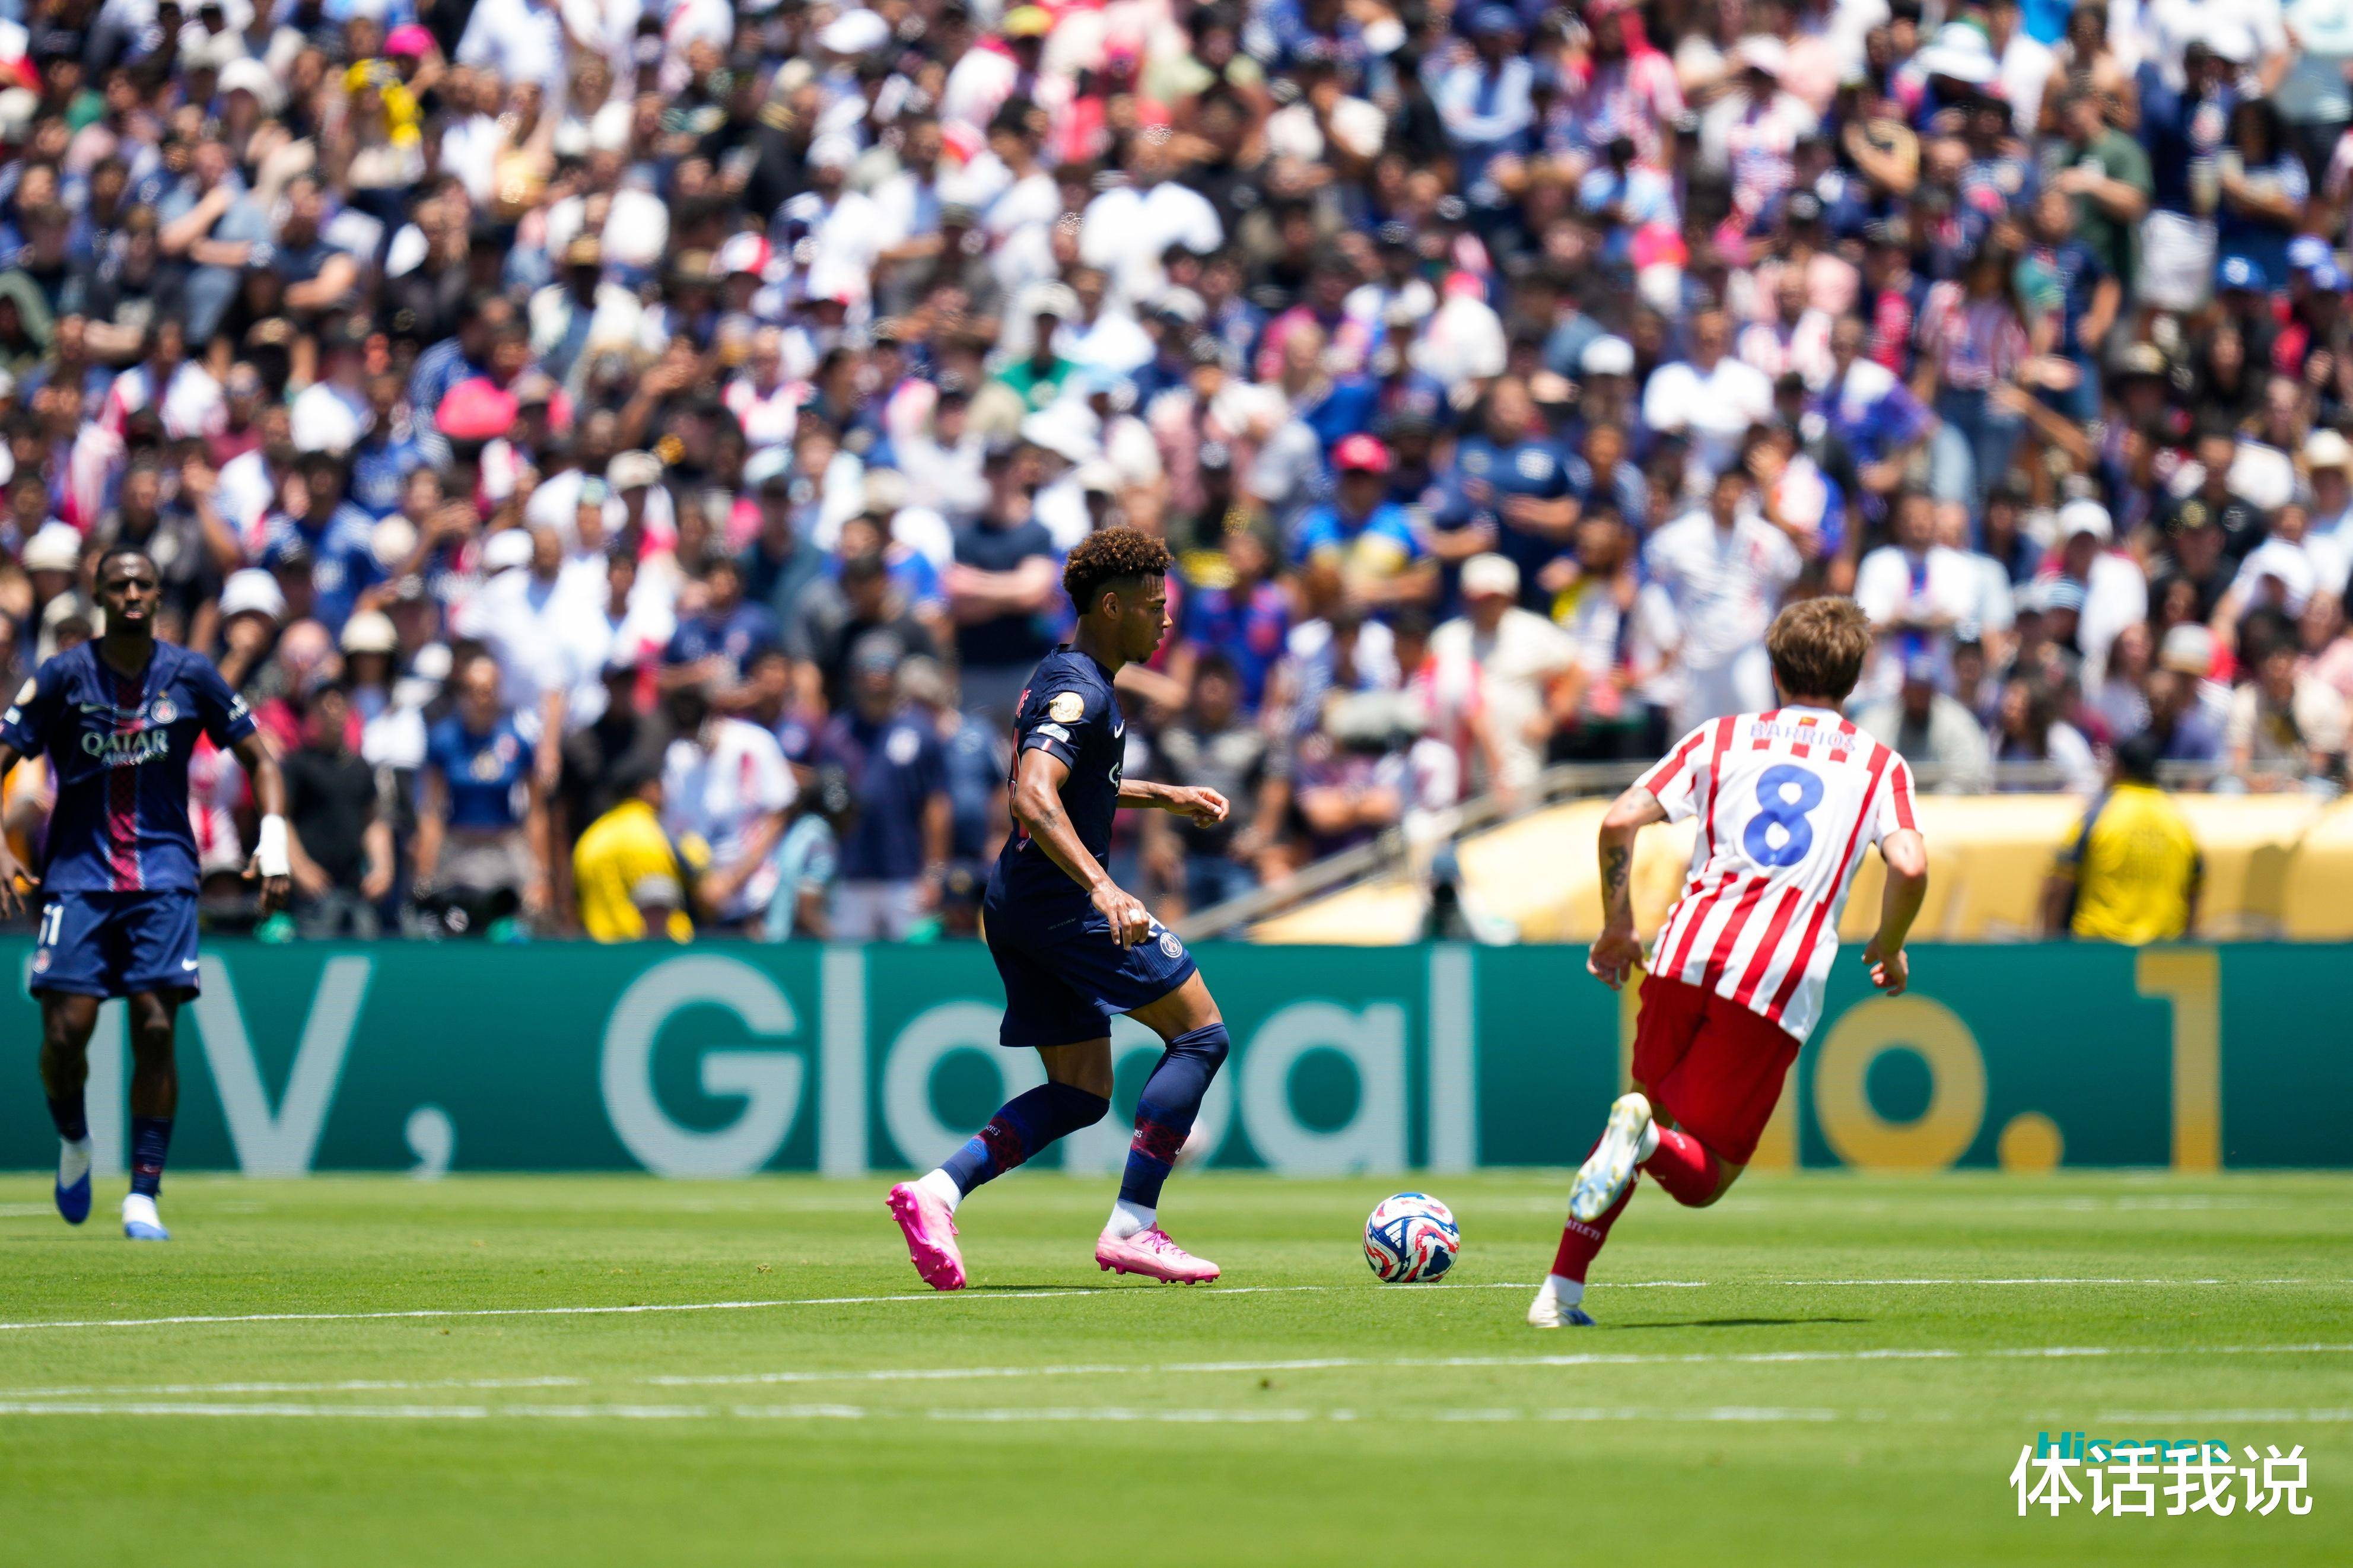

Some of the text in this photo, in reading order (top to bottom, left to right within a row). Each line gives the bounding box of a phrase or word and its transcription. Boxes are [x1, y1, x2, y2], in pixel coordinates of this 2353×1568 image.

[81, 729, 169, 758] QATAR
[1750, 722, 1856, 752] BARRIOS
[1744, 764, 1824, 867] 8
